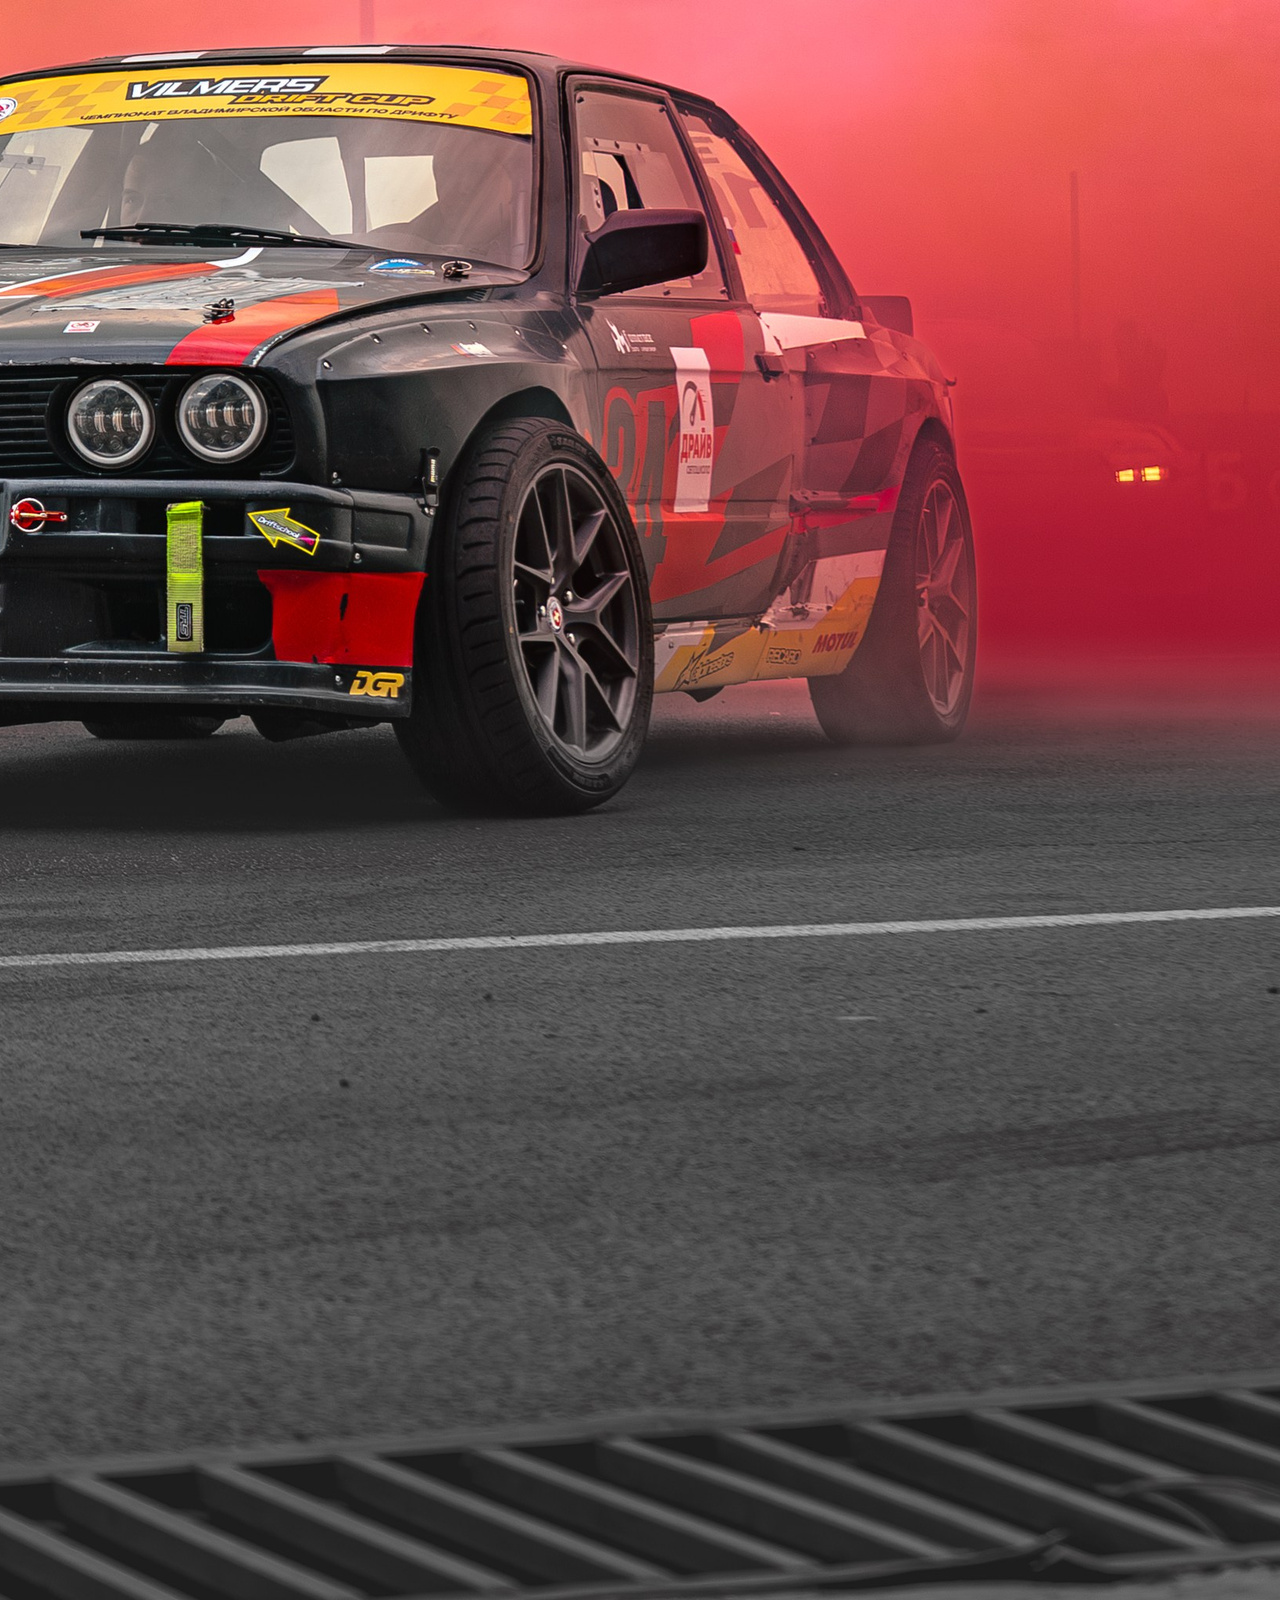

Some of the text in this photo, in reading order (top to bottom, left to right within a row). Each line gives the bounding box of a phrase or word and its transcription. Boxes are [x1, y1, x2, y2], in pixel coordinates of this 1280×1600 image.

[131, 77, 322, 98] VILMERS
[231, 92, 435, 107] DRIFT CUP
[80, 110, 166, 121] ЧЕМПИОНАТ
[167, 105, 290, 116] ВЛАДИМИРСКОЙ
[292, 106, 365, 114] ОБЛАСТИ
[389, 109, 459, 119] ДРИФТУ
[680, 427, 713, 464] ДРАЙВ
[812, 631, 858, 654] MOTUL
[349, 670, 405, 698] DGR
